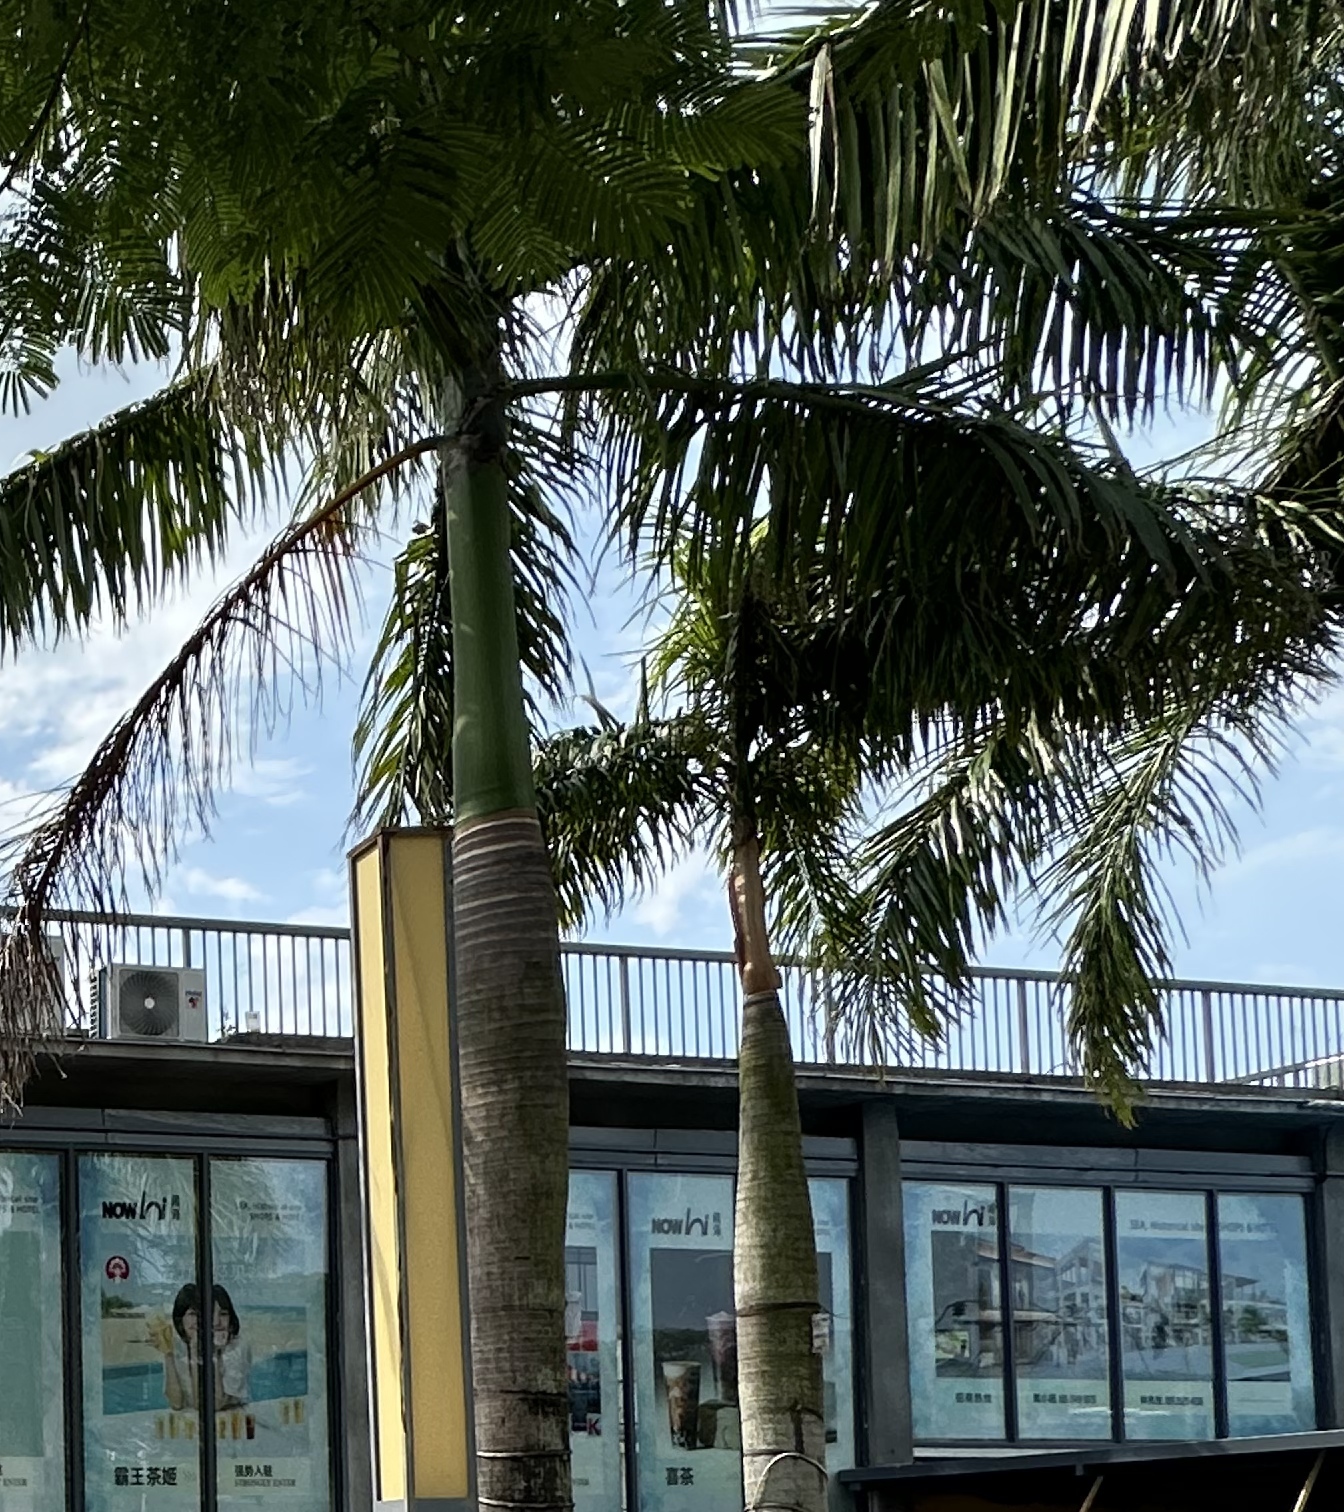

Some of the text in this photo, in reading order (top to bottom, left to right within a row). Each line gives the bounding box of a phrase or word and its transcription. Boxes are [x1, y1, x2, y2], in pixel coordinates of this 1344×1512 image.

[102, 1201, 137, 1220] NOW
[114, 1466, 177, 1486] 霸王茶姬
